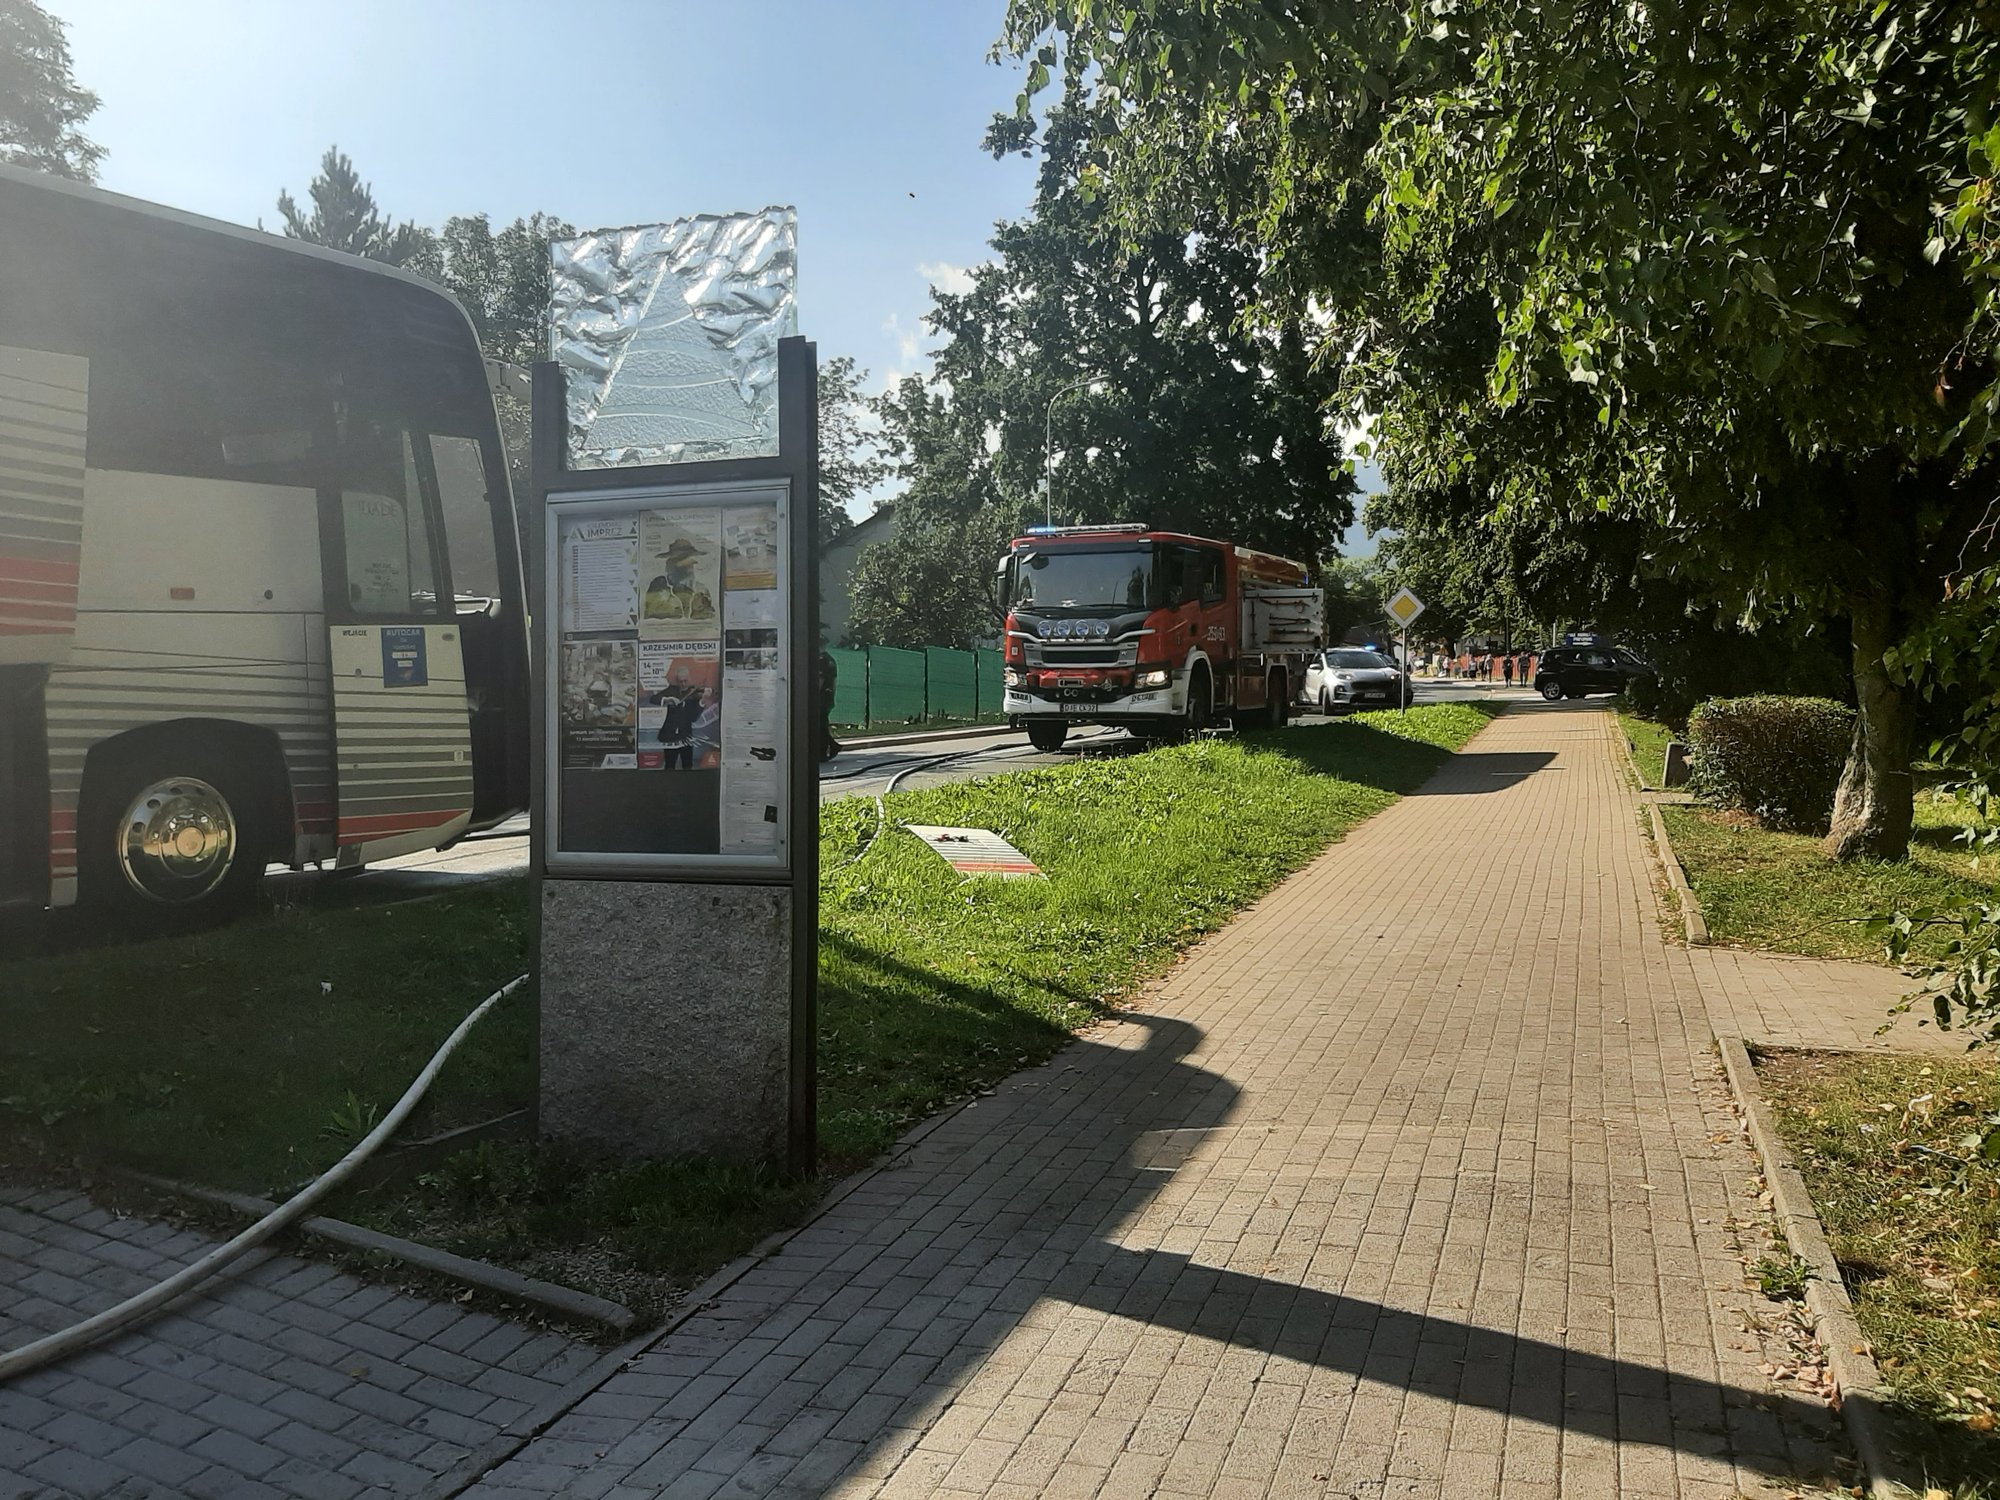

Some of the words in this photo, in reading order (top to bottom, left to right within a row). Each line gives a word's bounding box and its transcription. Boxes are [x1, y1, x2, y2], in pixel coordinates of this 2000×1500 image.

[587, 528, 623, 538] IMPREZ
[643, 643, 683, 652] KRZESIMIR
[685, 642, 716, 652] DĘBSKI
